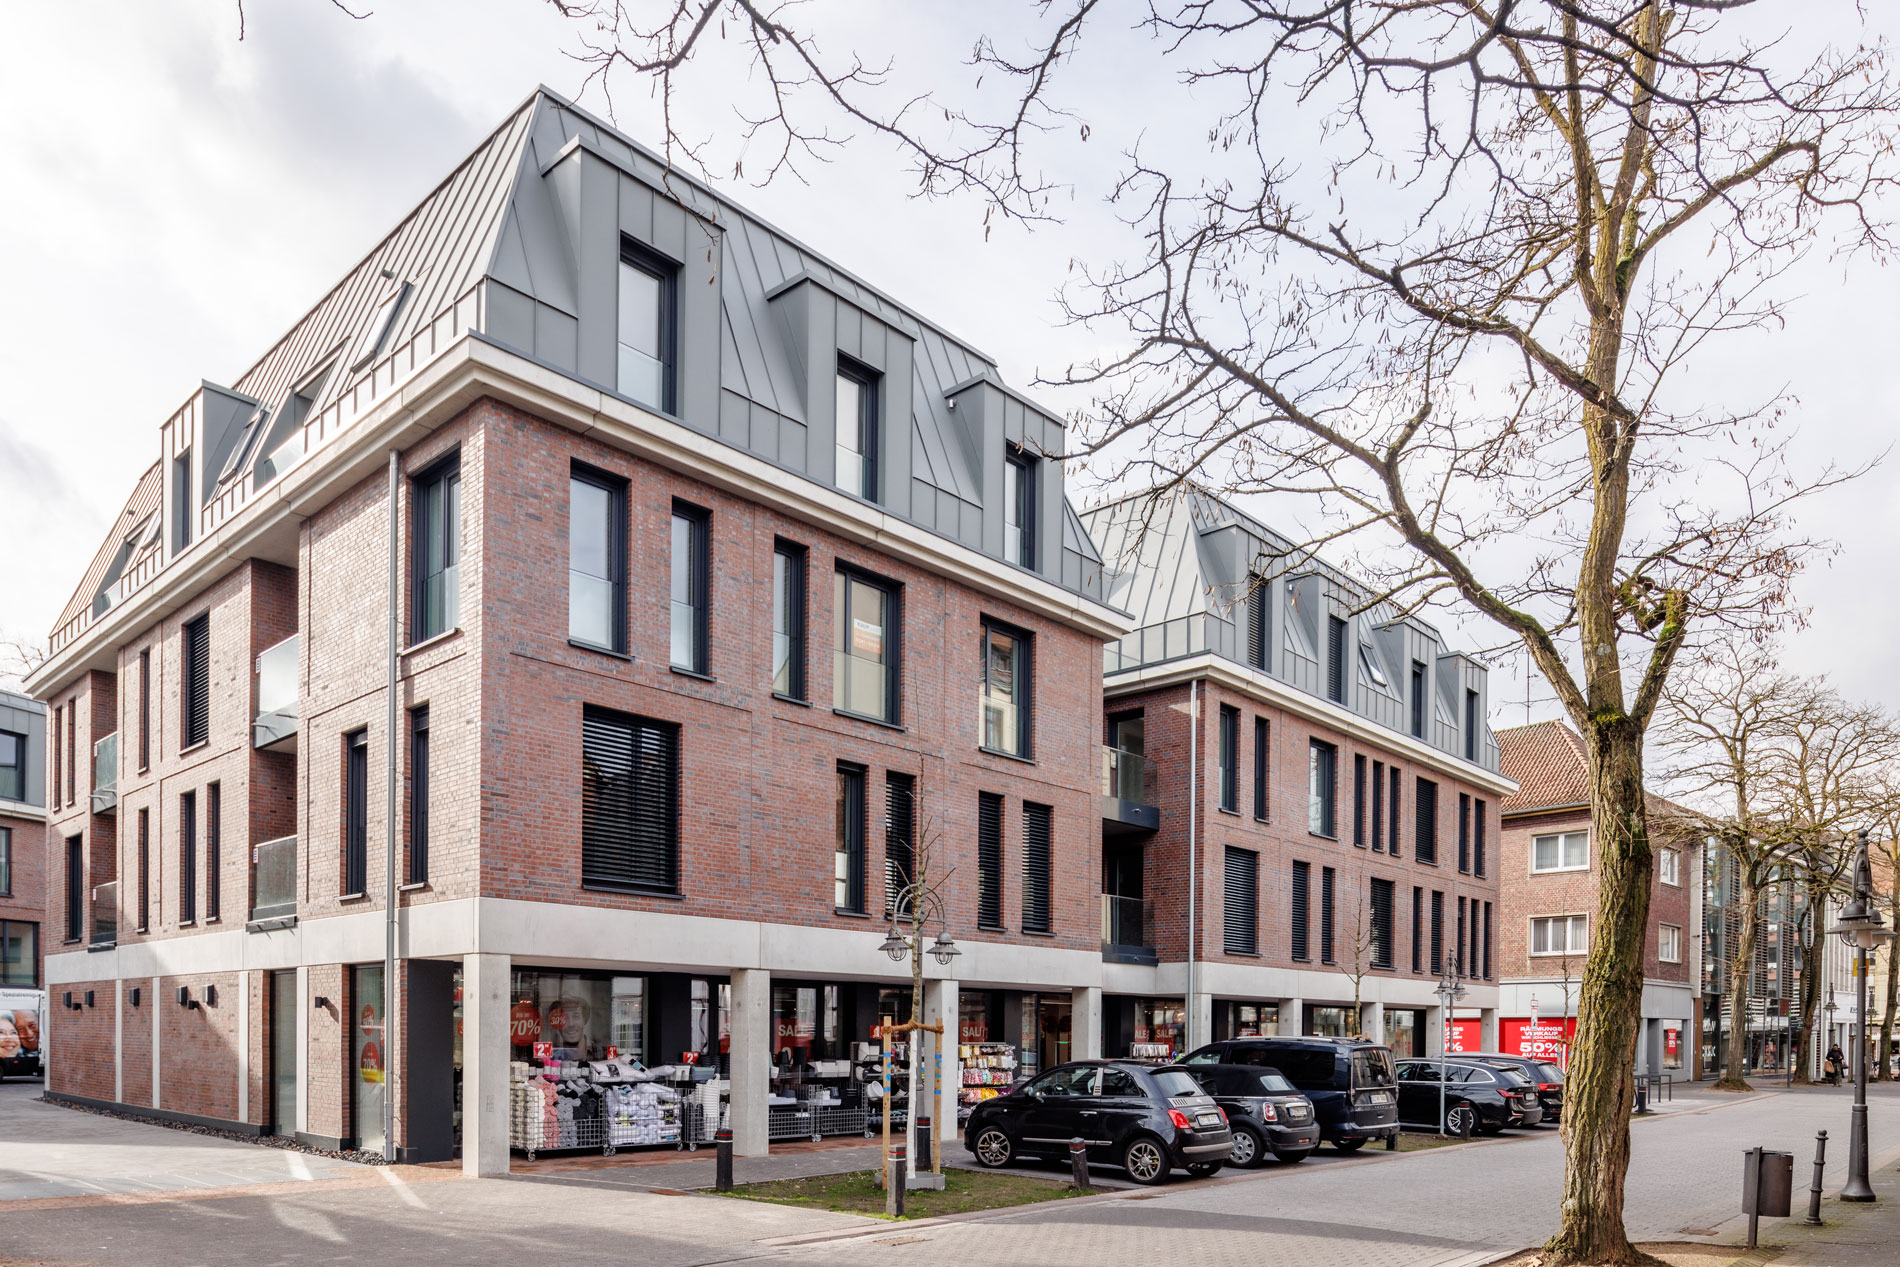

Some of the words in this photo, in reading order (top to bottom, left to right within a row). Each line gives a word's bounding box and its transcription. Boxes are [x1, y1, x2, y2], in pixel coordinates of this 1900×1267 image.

[511, 1019, 541, 1036] 70%
[1135, 1029, 1147, 1038] ALE
[1157, 1029, 1172, 1038] SALE
[1520, 1042, 1562, 1053] 50%
